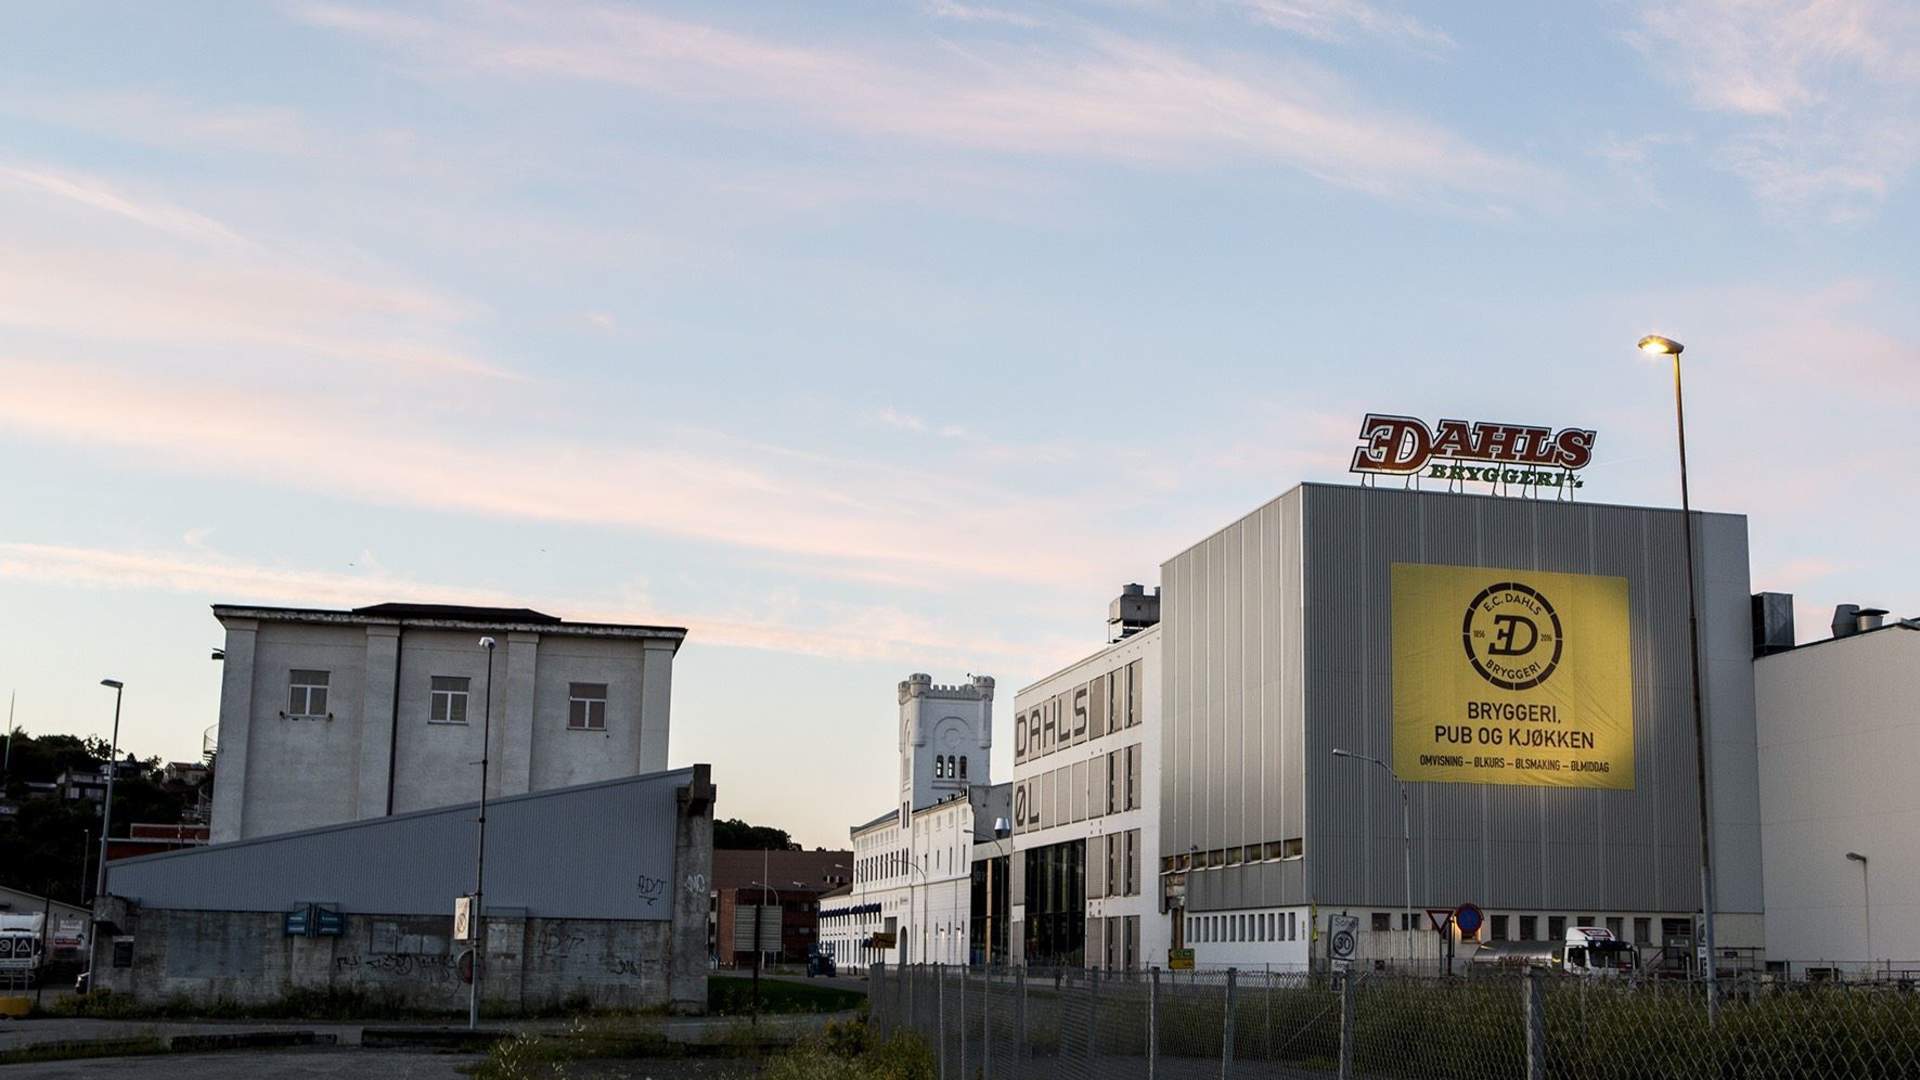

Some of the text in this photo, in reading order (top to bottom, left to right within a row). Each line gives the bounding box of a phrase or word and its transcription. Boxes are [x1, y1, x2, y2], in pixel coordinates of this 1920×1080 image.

[1428, 463, 1565, 488] BRYGGERI
[1505, 593, 1542, 616] DAHLS
[1486, 659, 1541, 680] BRYGGERI
[1016, 688, 1087, 758] DAHLS
[1435, 725, 1594, 749] PUB OG KJØKKEN
[1420, 754, 1610, 773] OMVISNING ØLKURS ØLSMAKING ØLMIDDAG
[1015, 783, 1040, 827] ØL
[1336, 936, 1351, 950] 30
